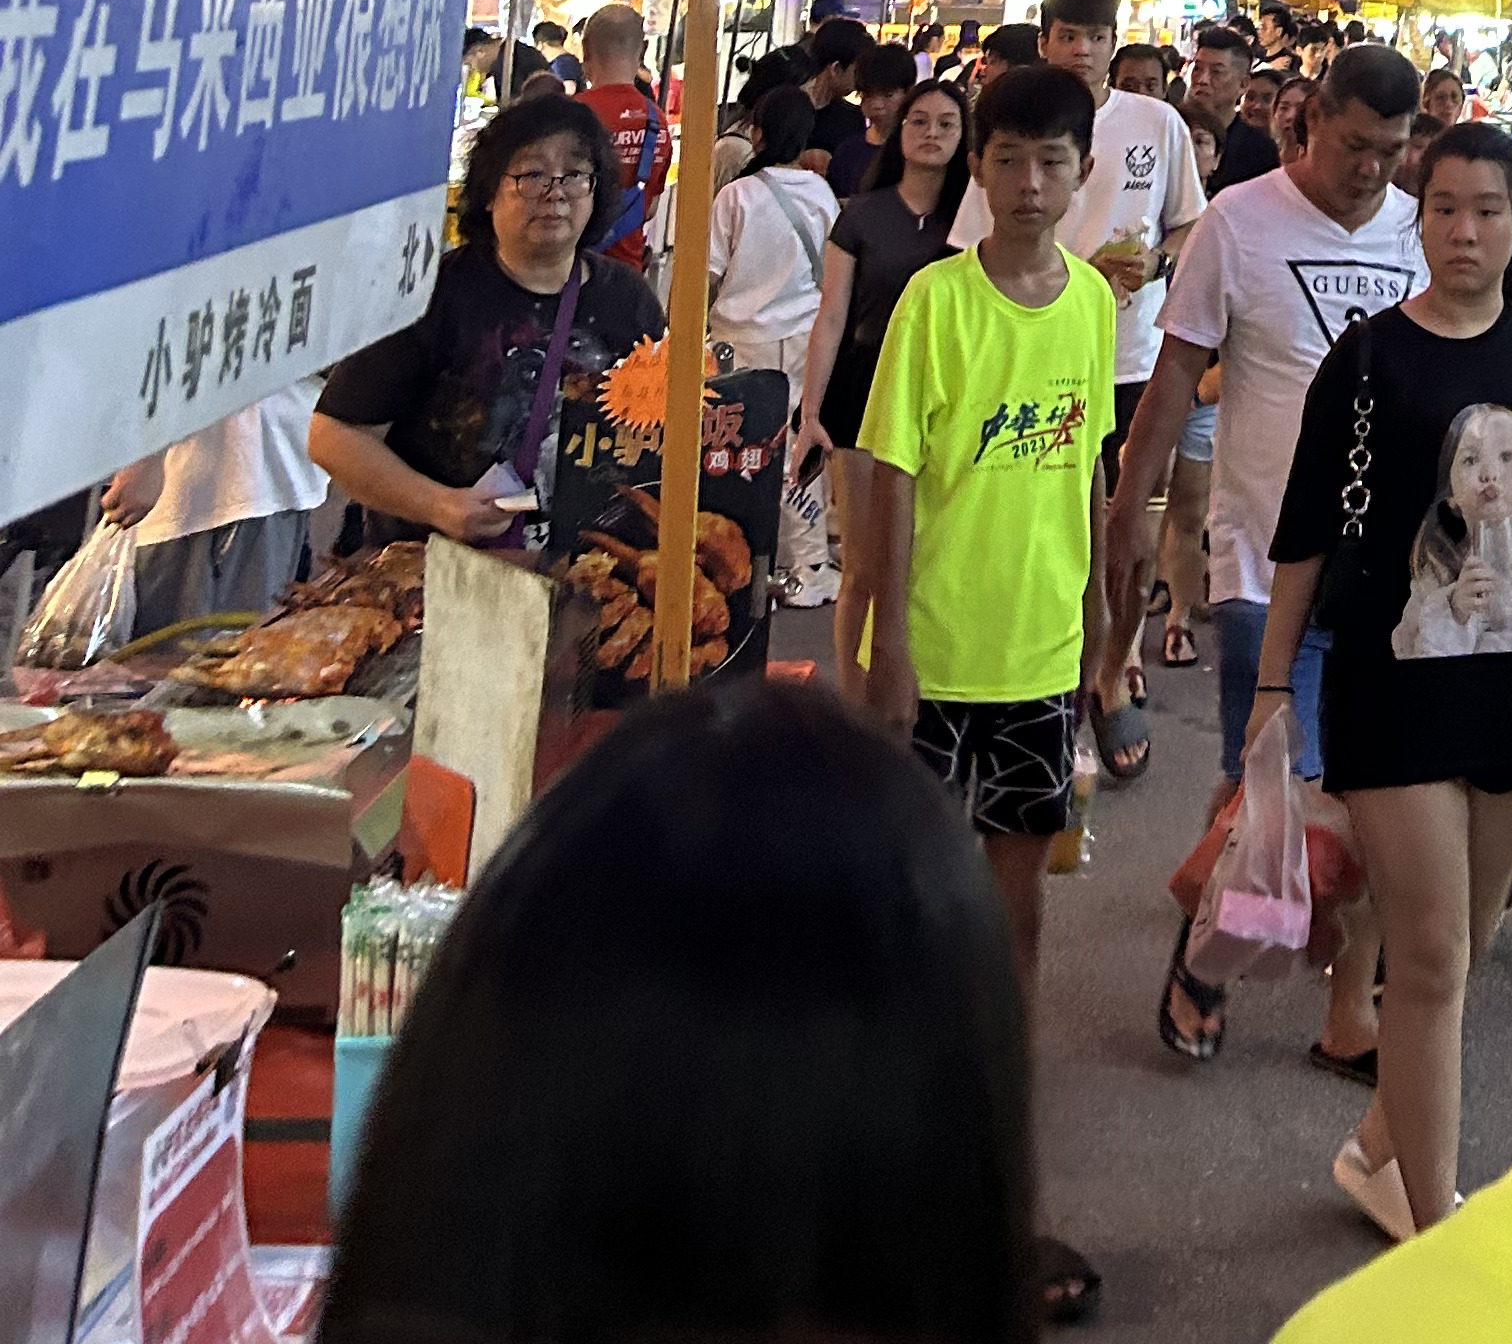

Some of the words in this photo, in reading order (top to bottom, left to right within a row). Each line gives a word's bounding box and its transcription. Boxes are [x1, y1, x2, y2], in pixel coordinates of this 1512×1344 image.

[398, 223, 420, 297] 北
[1312, 275, 1399, 299] GUESS
[139, 265, 318, 419] 小驴烤冷面
[1011, 435, 1046, 459] 2023
[708, 448, 762, 471] 鸡翅
